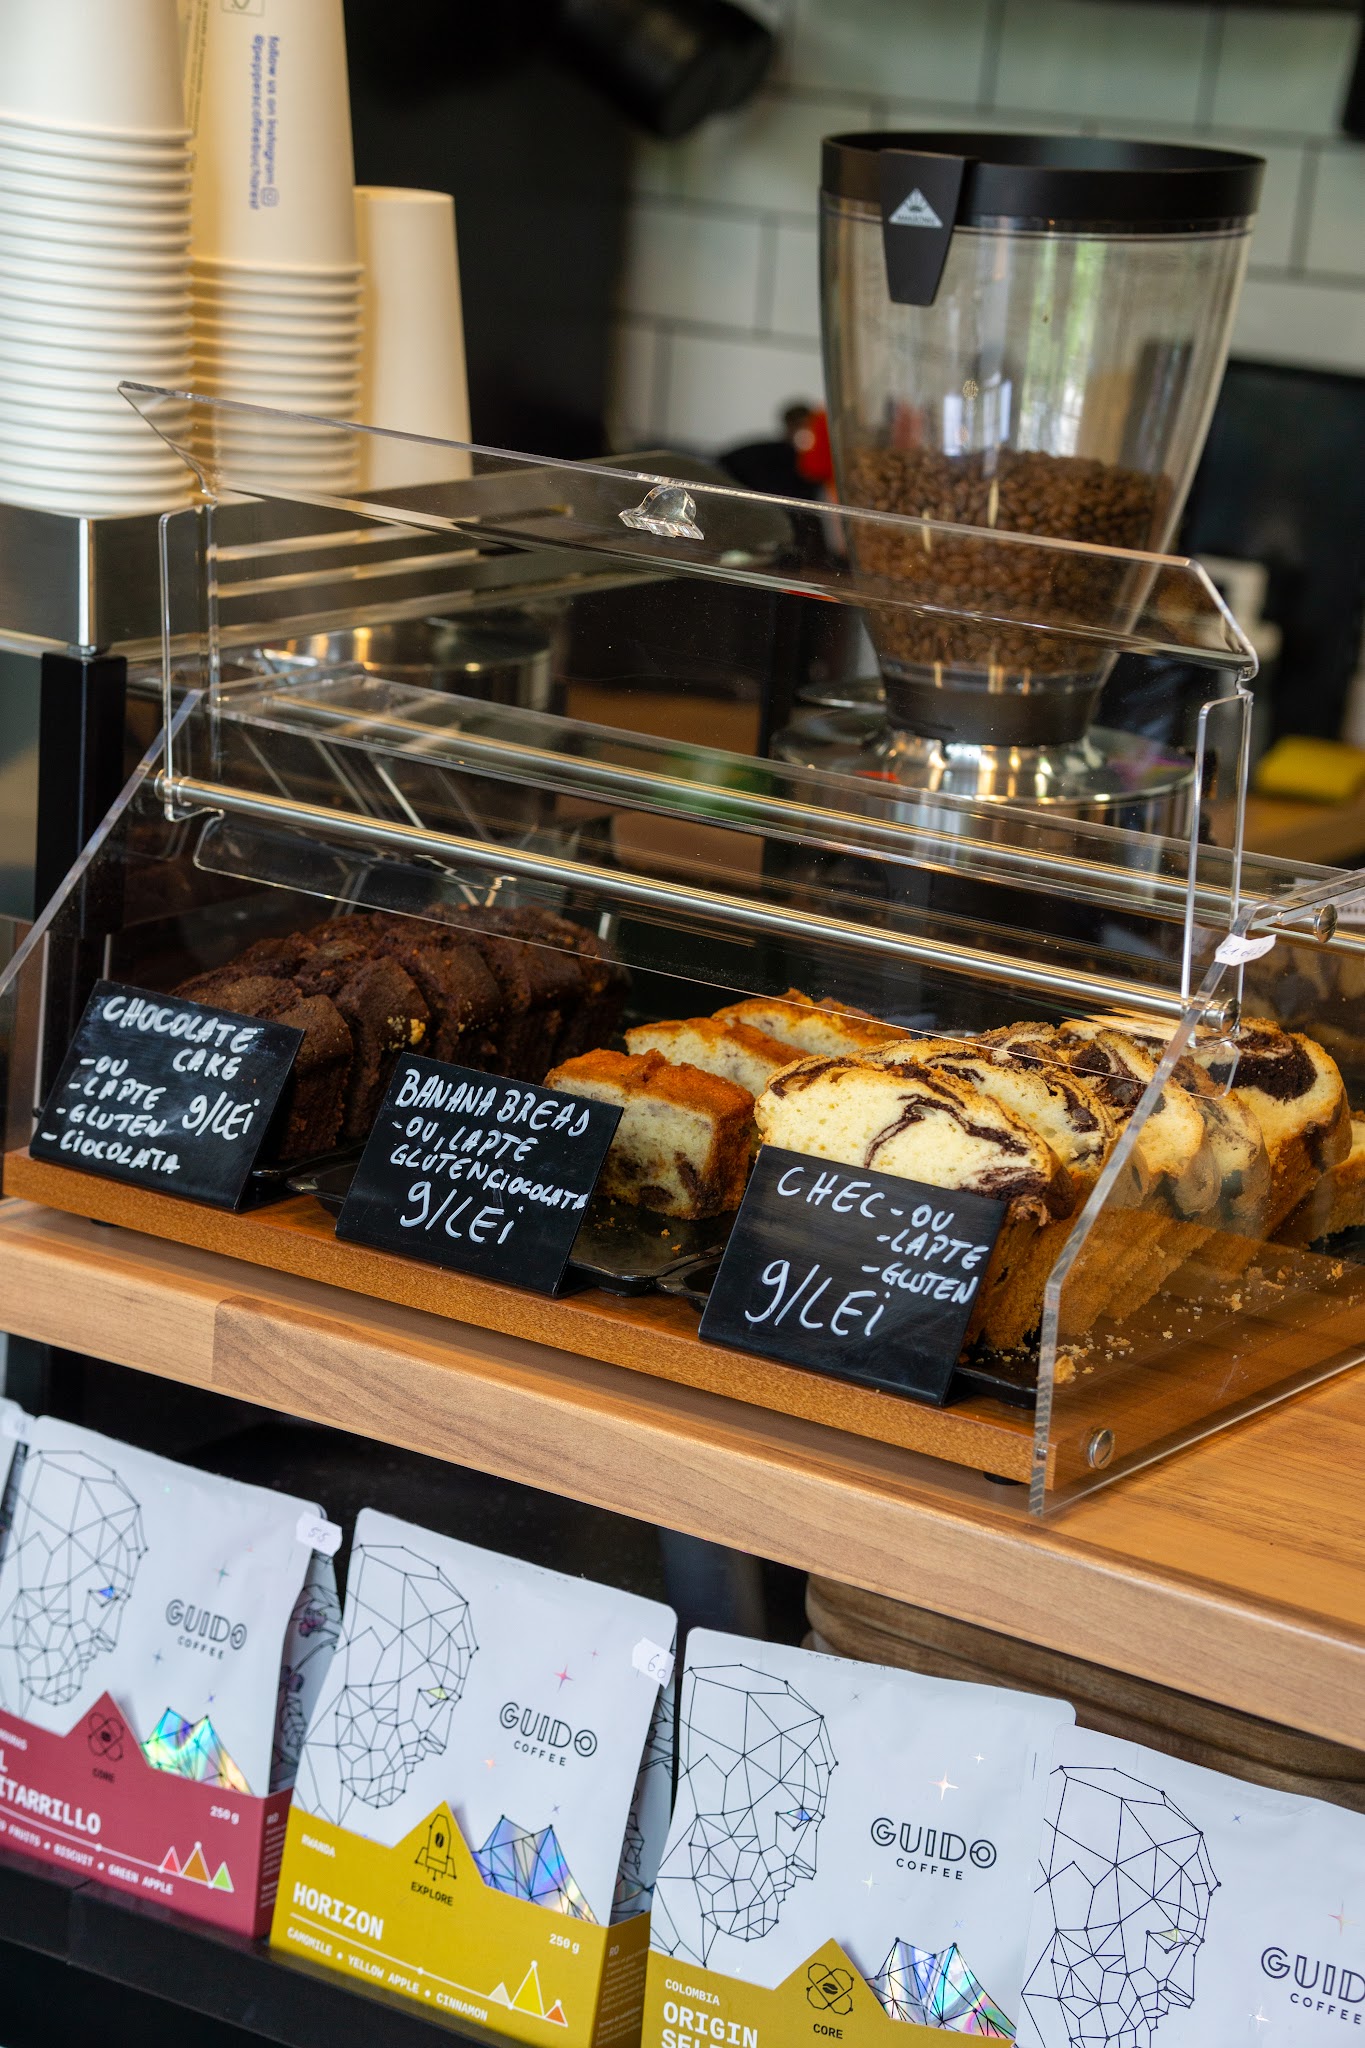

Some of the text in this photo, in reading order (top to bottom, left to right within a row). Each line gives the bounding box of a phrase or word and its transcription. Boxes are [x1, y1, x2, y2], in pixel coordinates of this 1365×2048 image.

[103, 996, 258, 1053] CHOCOLATE
[172, 1049, 242, 1081] CAKE
[395, 1068, 591, 1137] BANANA BREAD
[165, 1599, 247, 1650] GUIDO
[177, 1635, 225, 1660] COFFEE
[499, 1701, 598, 1757] GUIDO
[513, 1740, 567, 1767] COFFEE
[210, 1805, 231, 1821] 250
[301, 1833, 337, 1859] RWANDA
[870, 1817, 997, 1869] GUIDO
[107, 1863, 139, 1884] GREEN
[142, 1876, 174, 1895] APPLE
[896, 1858, 963, 1881] COFFEE
[410, 1881, 454, 1907] EXPLORE
[293, 1881, 384, 1941] HORIZON
[549, 1932, 580, 1955] 250 g
[287, 1926, 488, 2022] CAMOMILE YELLOW APPLE CINNAMON
[665, 1978, 720, 2006] COLOMBIA
[663, 2001, 758, 2048] ORIGIN
[1290, 1993, 1362, 2025] COFFEE
[813, 2023, 844, 2040] CORE
